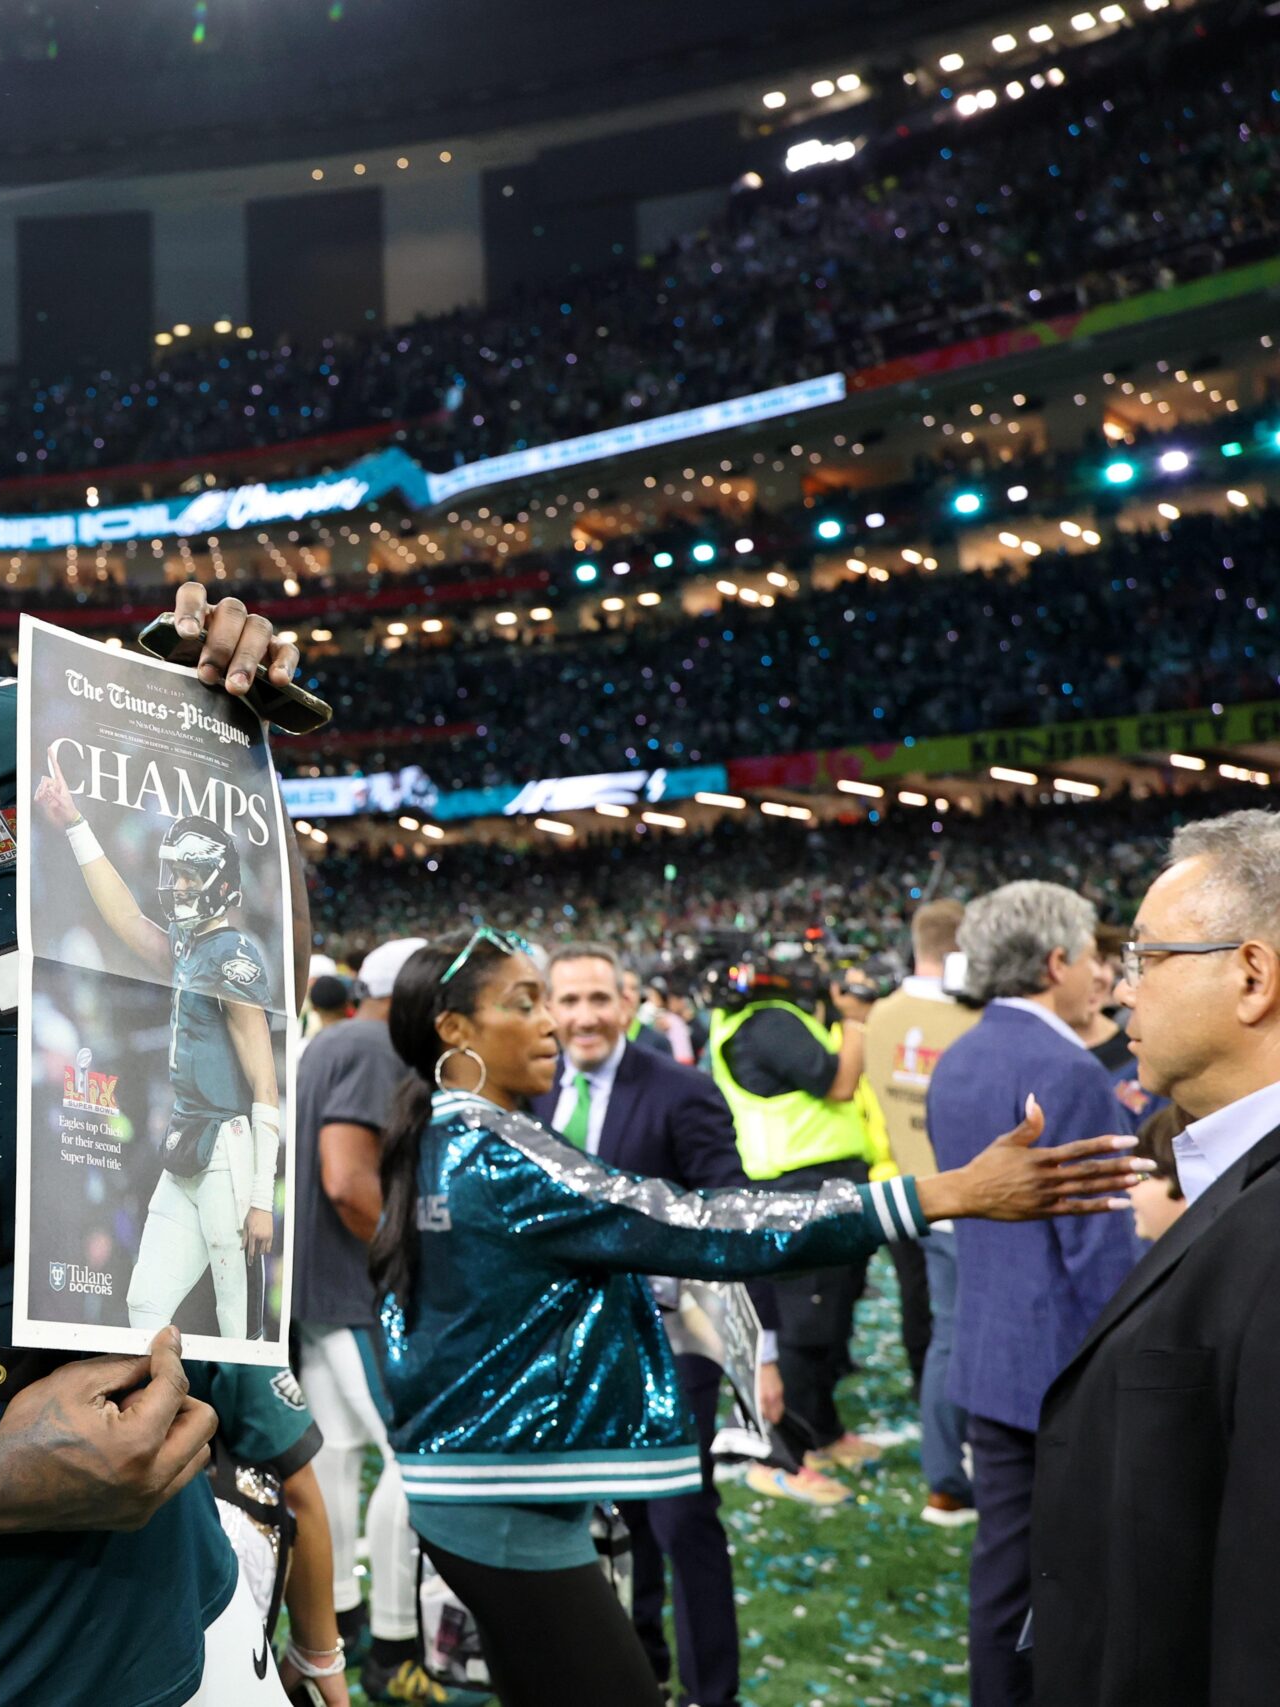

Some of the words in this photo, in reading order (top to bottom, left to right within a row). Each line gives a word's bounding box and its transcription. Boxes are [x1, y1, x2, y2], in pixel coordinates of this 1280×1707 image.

[146, 684, 167, 695] SINCE
[65, 669, 105, 702] The
[106, 683, 251, 749] Times-Picayune
[47, 737, 270, 846] CHAMPS
[68, 1100, 93, 1111] SUPER
[94, 1106, 115, 1116] BOWL
[59, 1115, 85, 1131] Eagles
[86, 1120, 99, 1135] top
[99, 1123, 124, 1138] Chiefs
[61, 1132, 73, 1145] for
[75, 1134, 94, 1149] their
[94, 1141, 121, 1154] second
[60, 1149, 86, 1165] Super
[86, 1153, 106, 1168] Bowl
[106, 1158, 122, 1171] title
[66, 1264, 113, 1286] Tulane
[69, 1282, 113, 1296] DOCTORS
